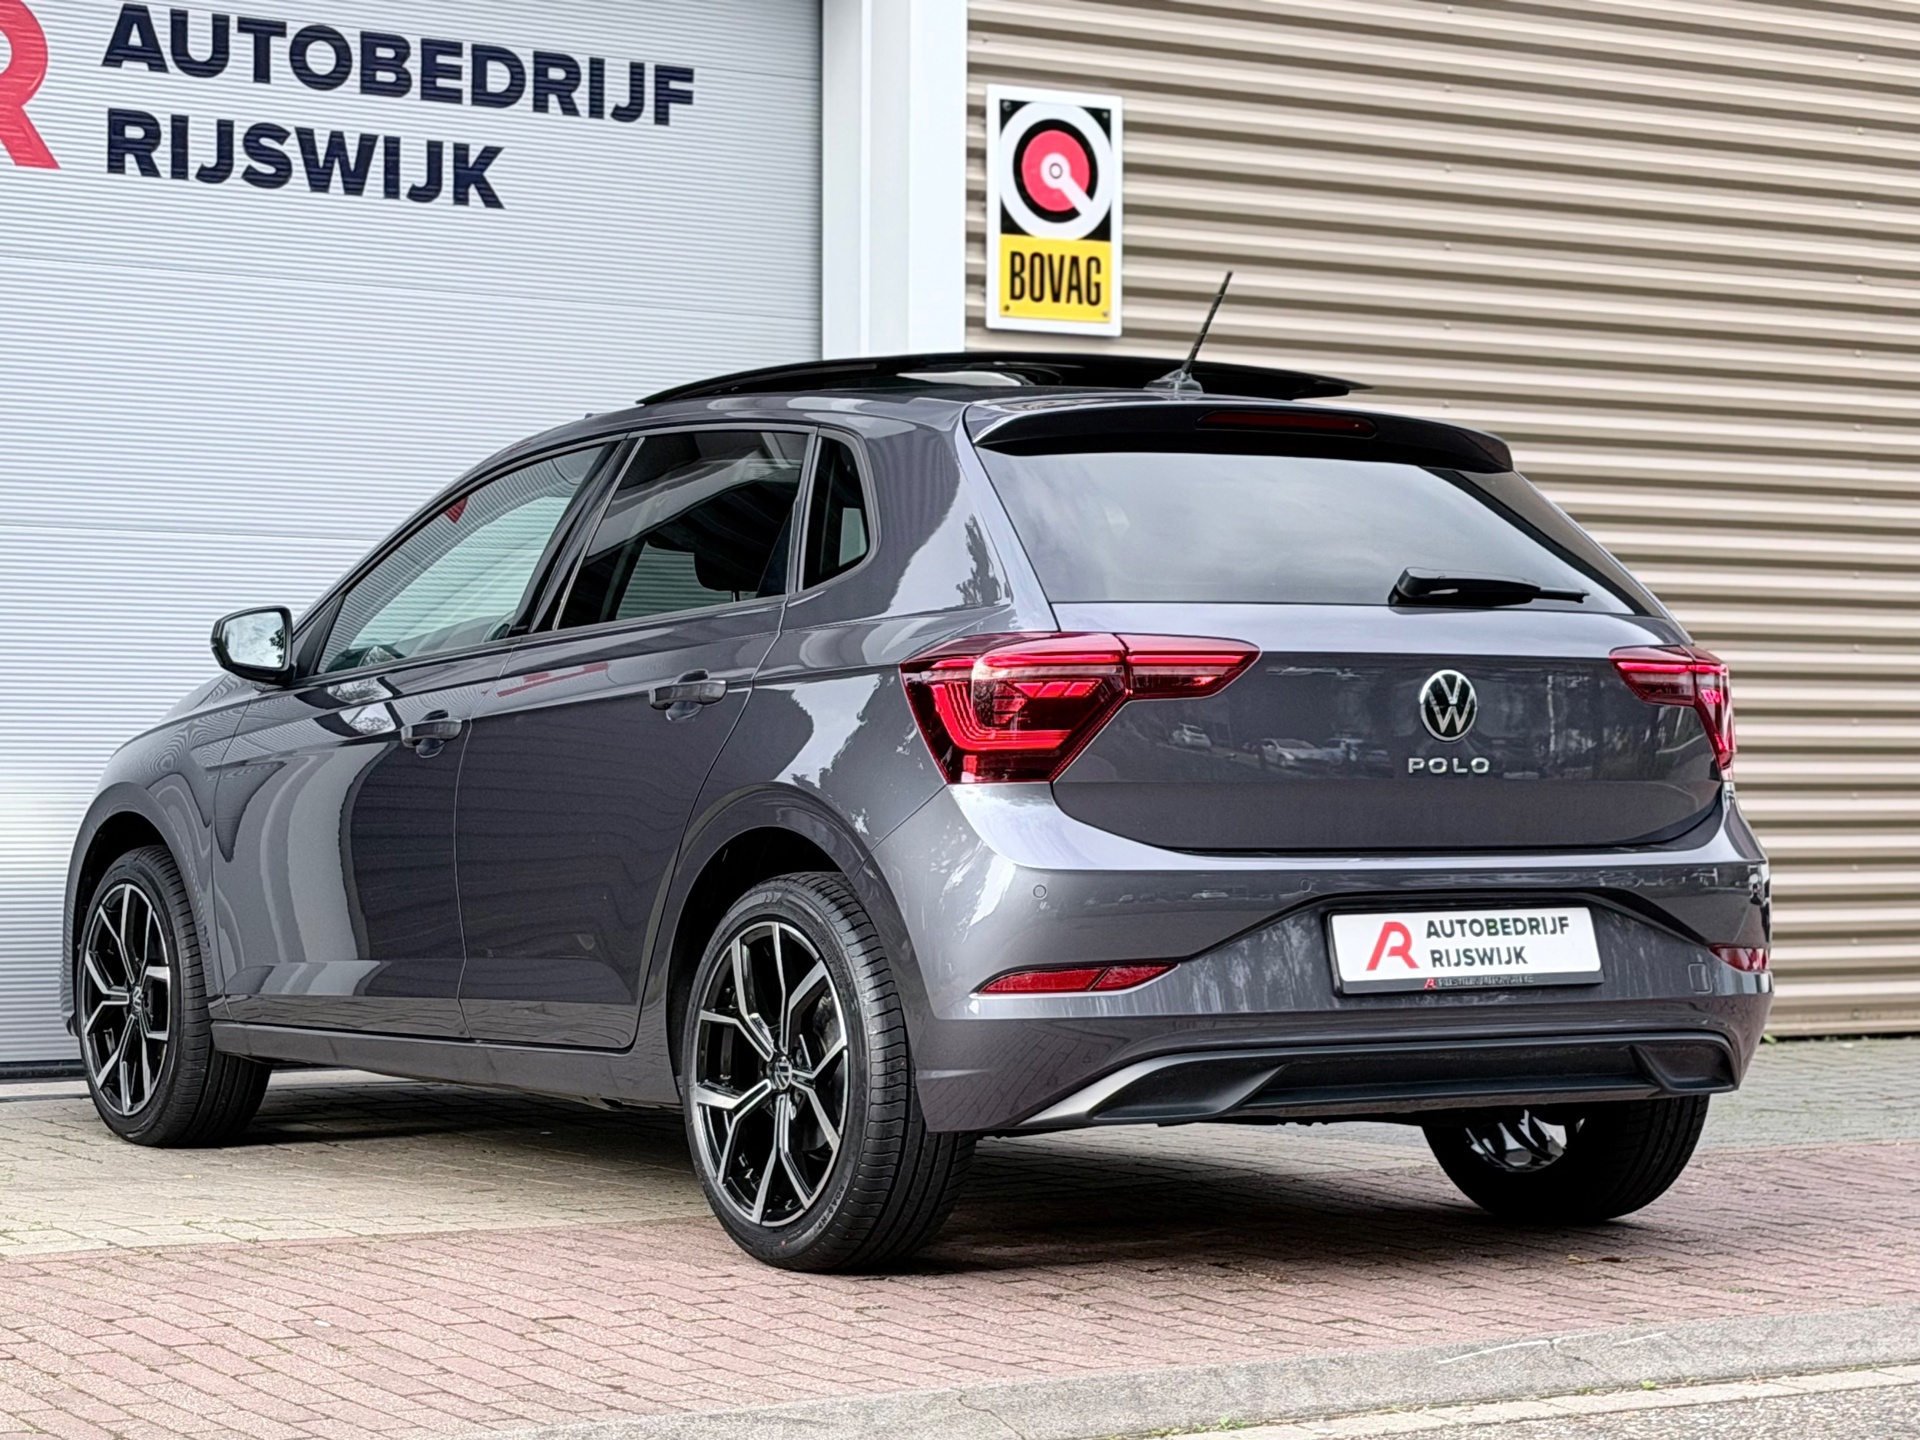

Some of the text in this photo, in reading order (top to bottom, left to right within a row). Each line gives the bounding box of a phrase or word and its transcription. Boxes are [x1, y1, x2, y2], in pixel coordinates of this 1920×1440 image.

[102, 3, 695, 125] AUTOBEDRIJF
[106, 108, 505, 209] RIJSWIJK
[1010, 251, 1101, 306] BOVAG
[1408, 757, 1490, 774] POLO
[1426, 916, 1570, 939] AUTOBEDRIJF
[1430, 946, 1528, 968] RIJSWIJK
